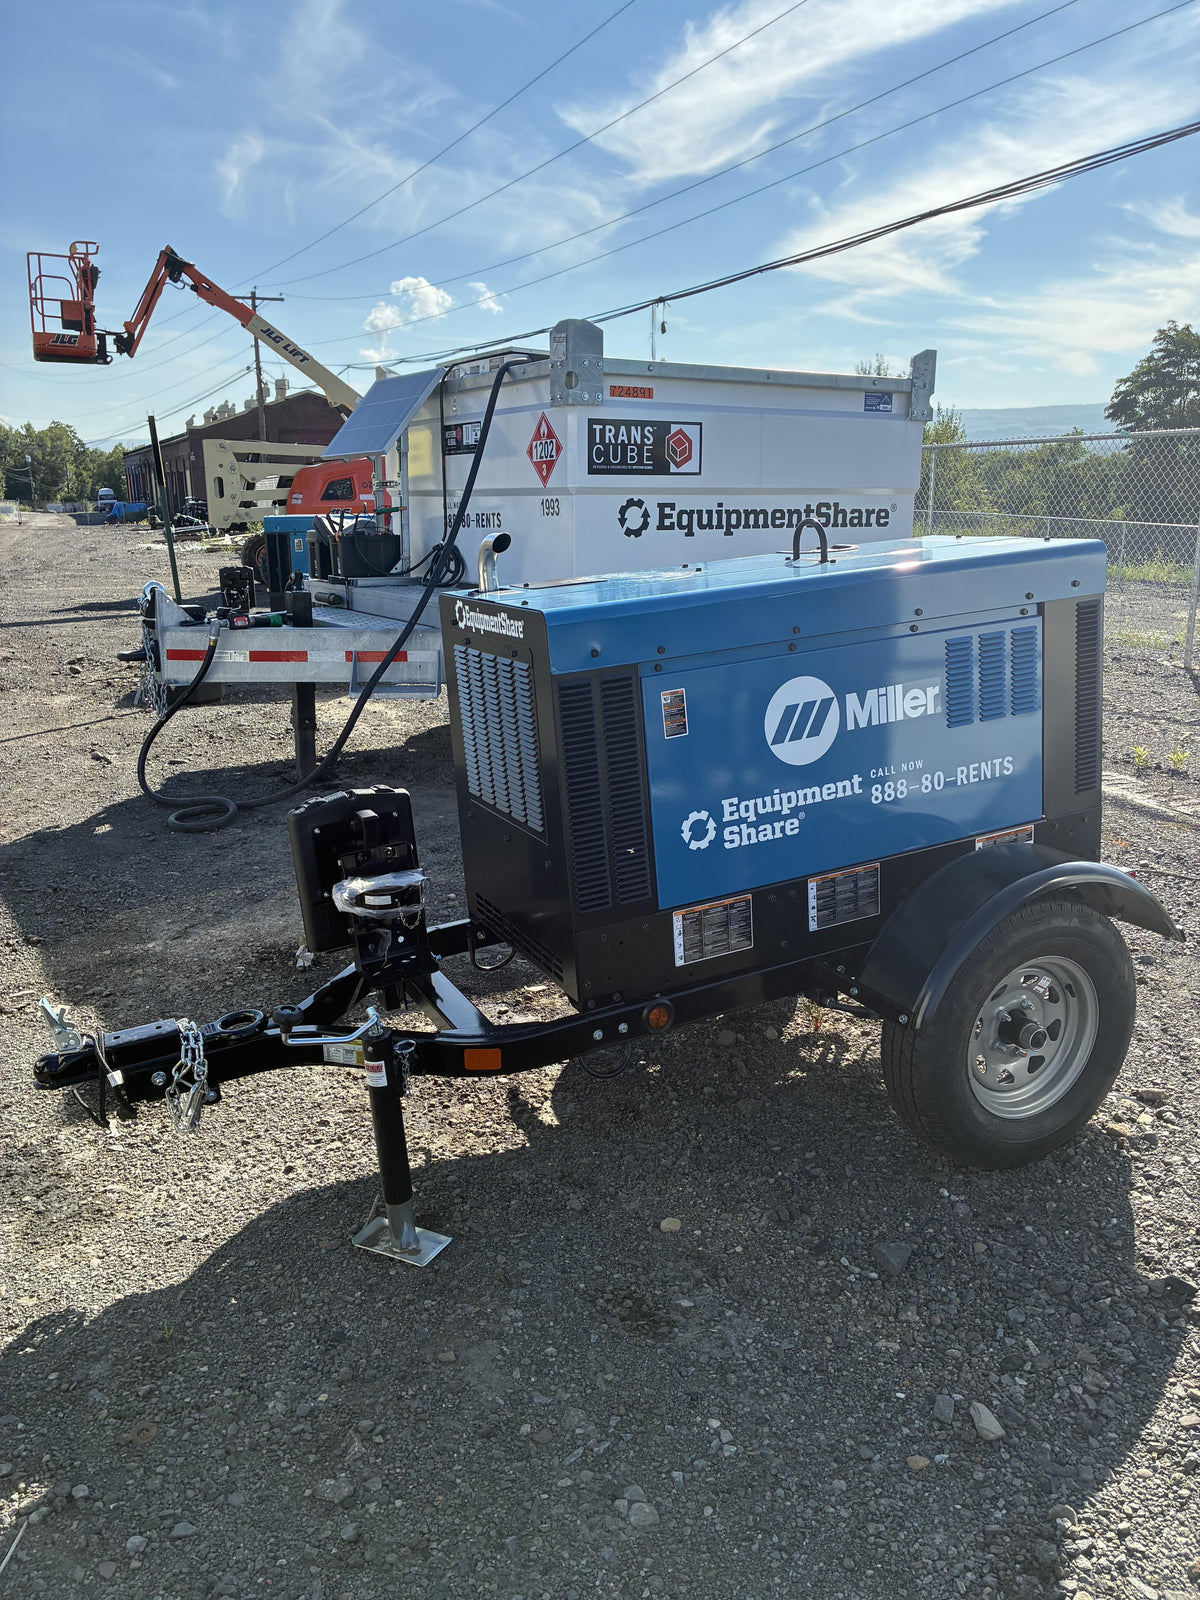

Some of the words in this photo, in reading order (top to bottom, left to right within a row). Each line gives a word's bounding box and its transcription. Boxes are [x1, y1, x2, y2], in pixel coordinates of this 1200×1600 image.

[50, 333, 79, 345] JLG
[260, 328, 284, 344] JLG
[282, 343, 310, 363] LIFT
[609, 386, 651, 398] 724891
[593, 424, 654, 444] TRANS
[534, 440, 555, 460] 1202
[592, 445, 653, 464] CUBE
[541, 464, 548, 477] 3
[541, 498, 560, 516] 1993
[870, 766, 896, 779] CALL
[901, 759, 924, 772] NOW
[870, 756, 1013, 804] 888-80-RENTS
[722, 774, 862, 821] Equipment
